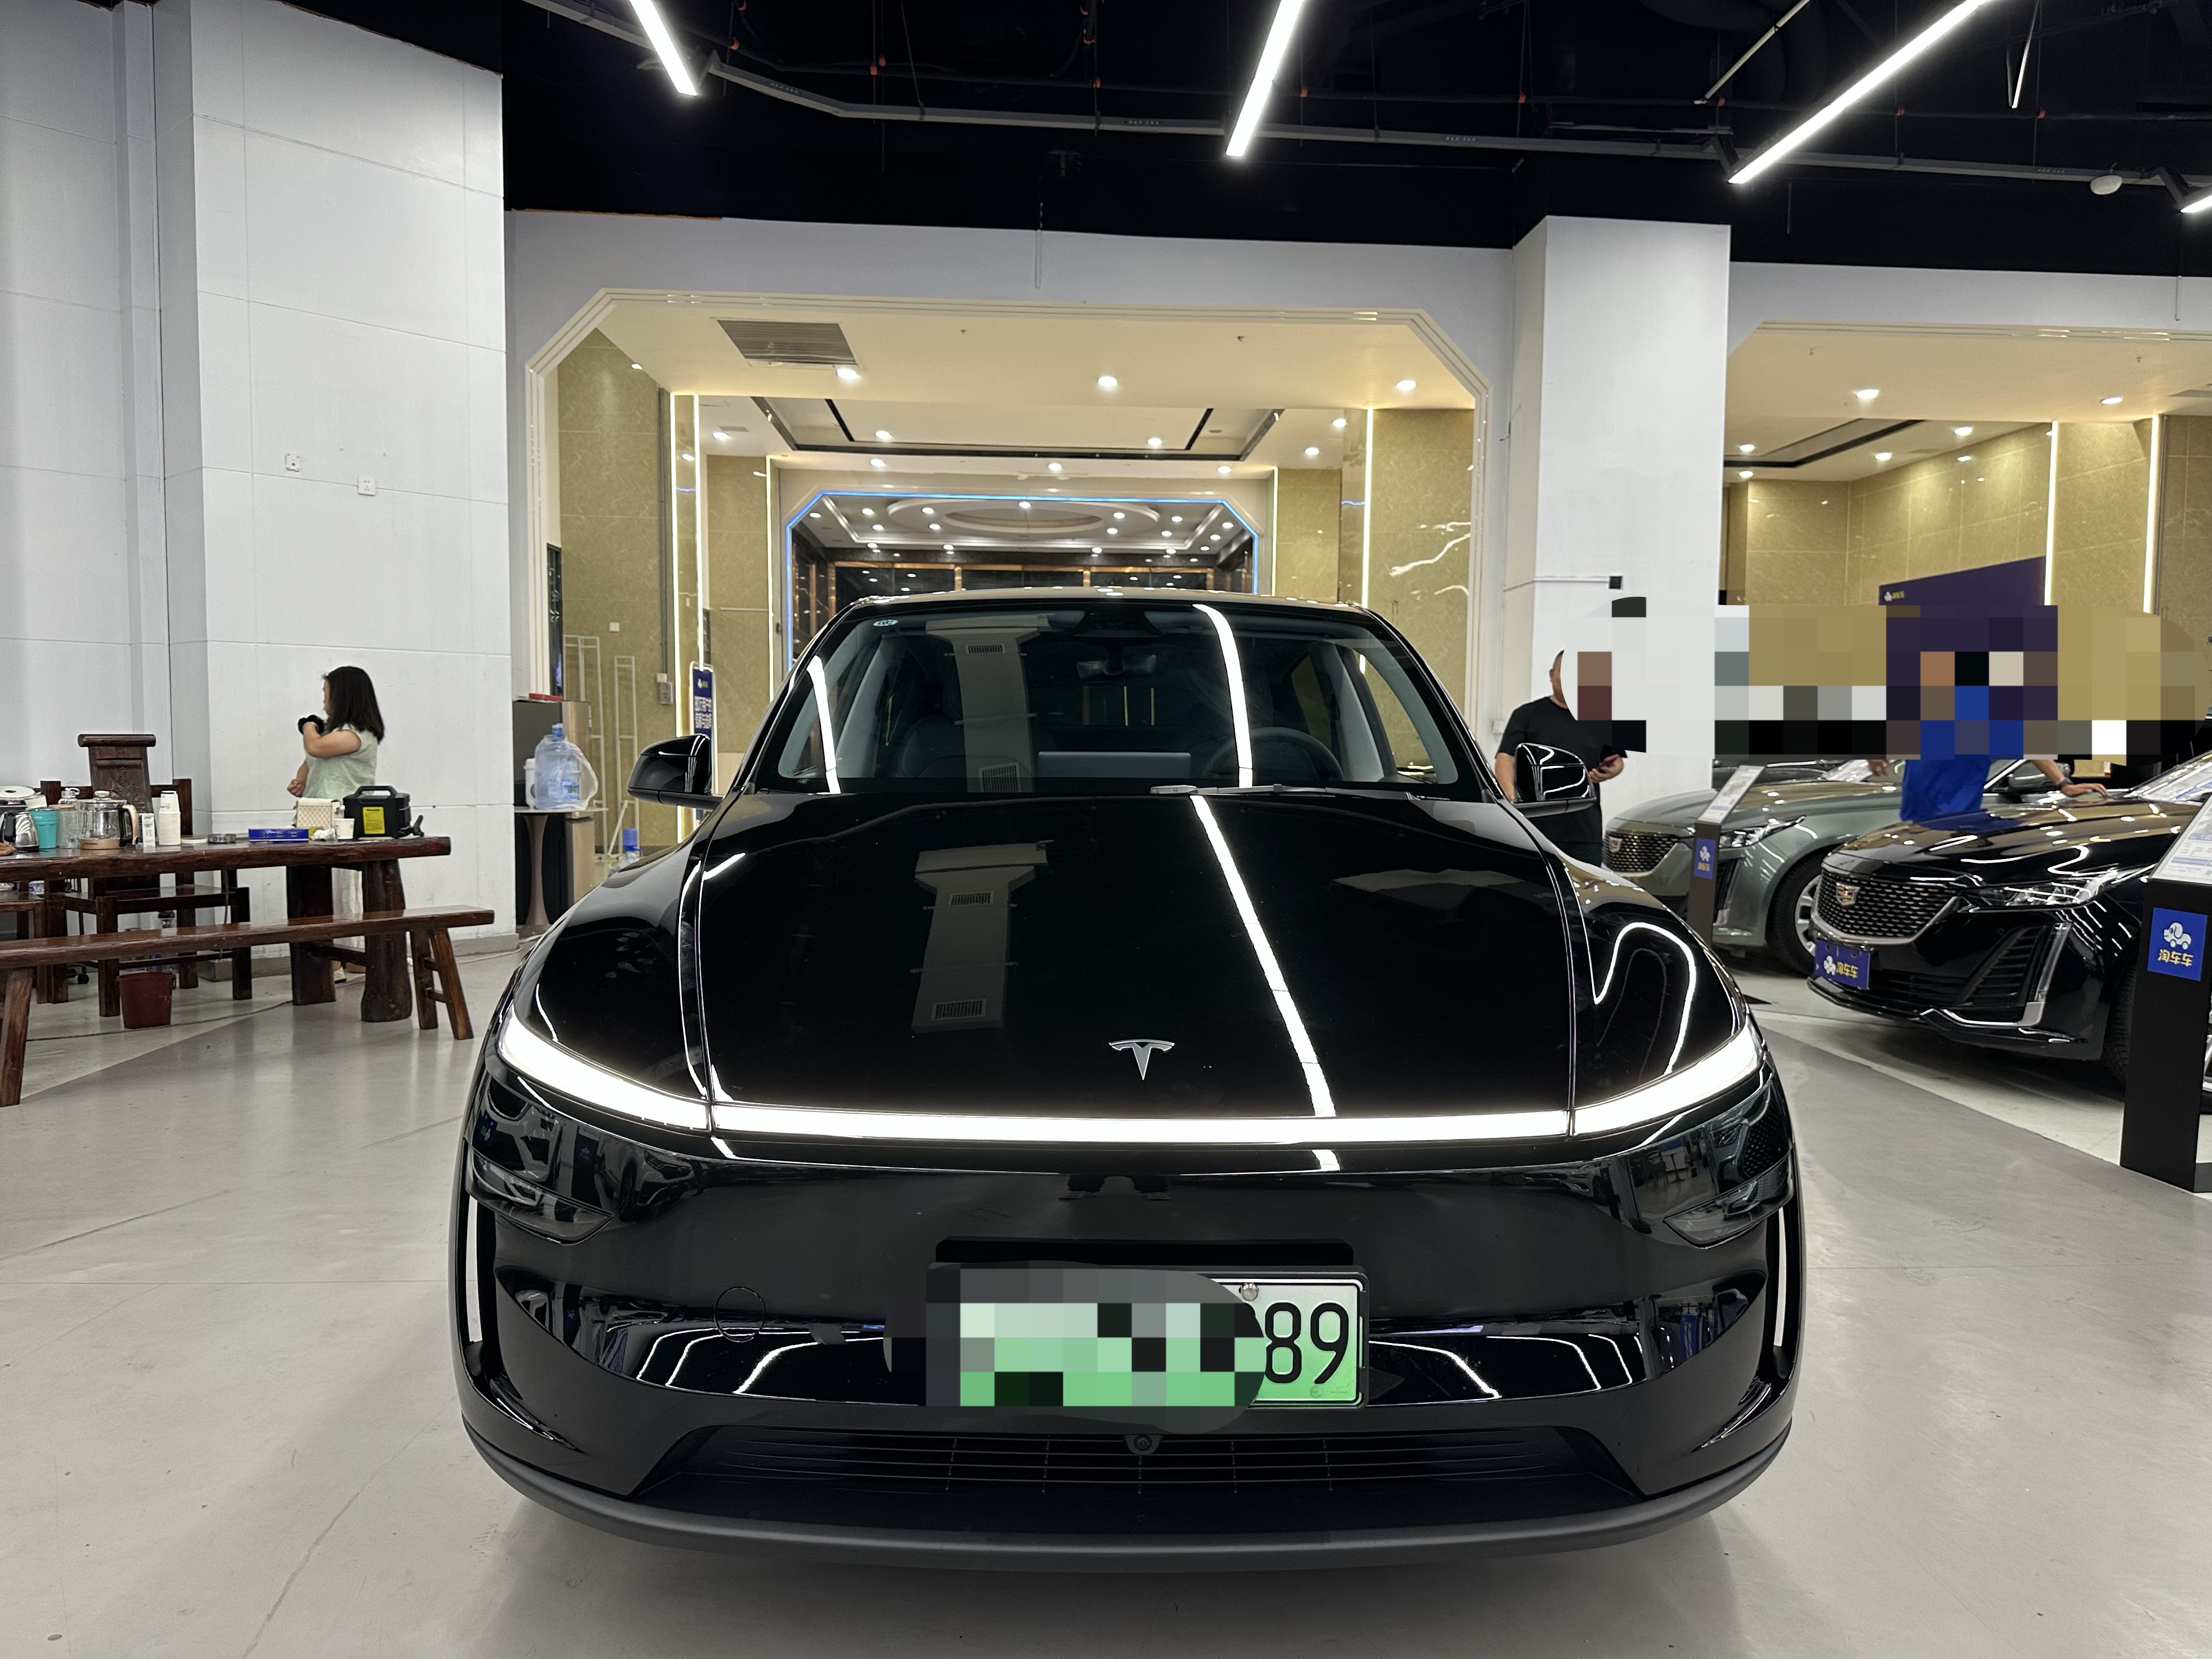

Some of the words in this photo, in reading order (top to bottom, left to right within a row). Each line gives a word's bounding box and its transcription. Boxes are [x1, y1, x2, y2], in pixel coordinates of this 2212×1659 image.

[2157, 949, 2193, 967] 淘车车
[1836, 961, 1858, 978] 淘车车
